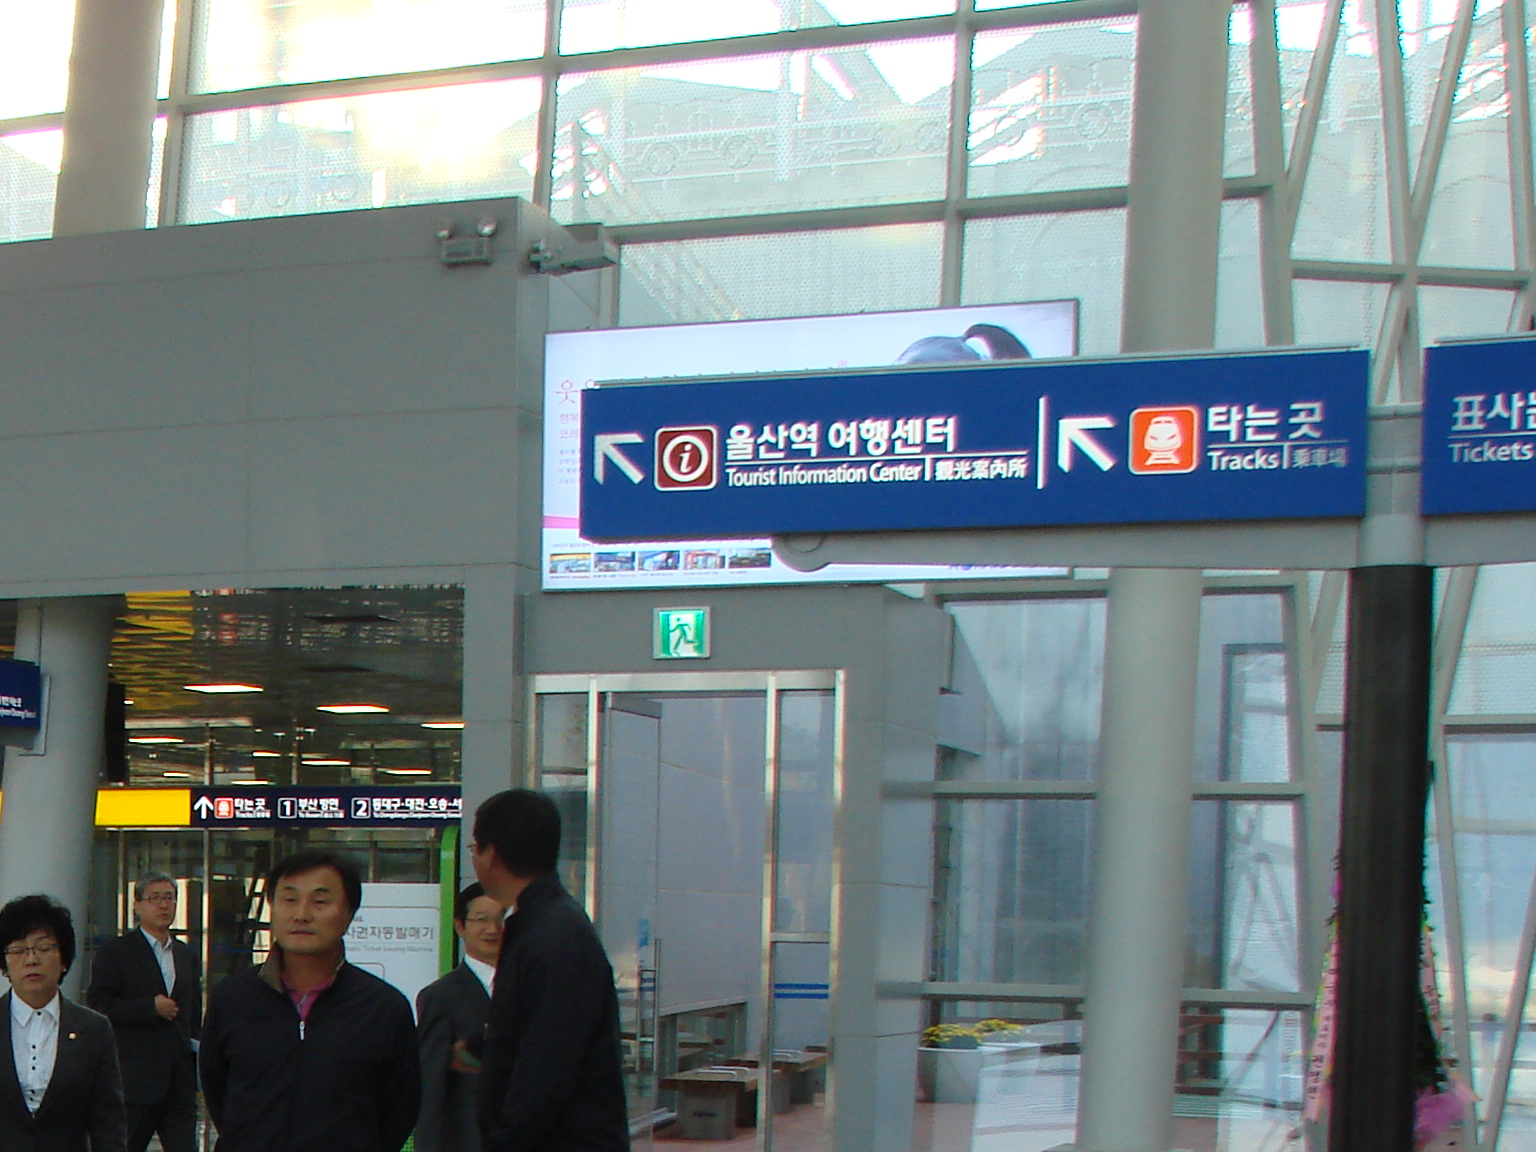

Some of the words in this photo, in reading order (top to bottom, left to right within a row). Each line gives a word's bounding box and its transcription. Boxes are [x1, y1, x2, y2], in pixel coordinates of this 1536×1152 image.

[1207, 403, 1280, 442] 타는
[1288, 400, 1325, 439] 곳
[1450, 391, 1536, 431] 표사
[725, 422, 818, 461] 울산역
[828, 416, 958, 456] 여행센터
[1207, 449, 1280, 471] Tracks
[1447, 440, 1534, 463] Tickets
[725, 466, 777, 488] Tourist
[778, 463, 866, 486] Information
[869, 462, 921, 484] Center
[298, 798, 318, 811] 부산
[356, 800, 368, 817] 2
